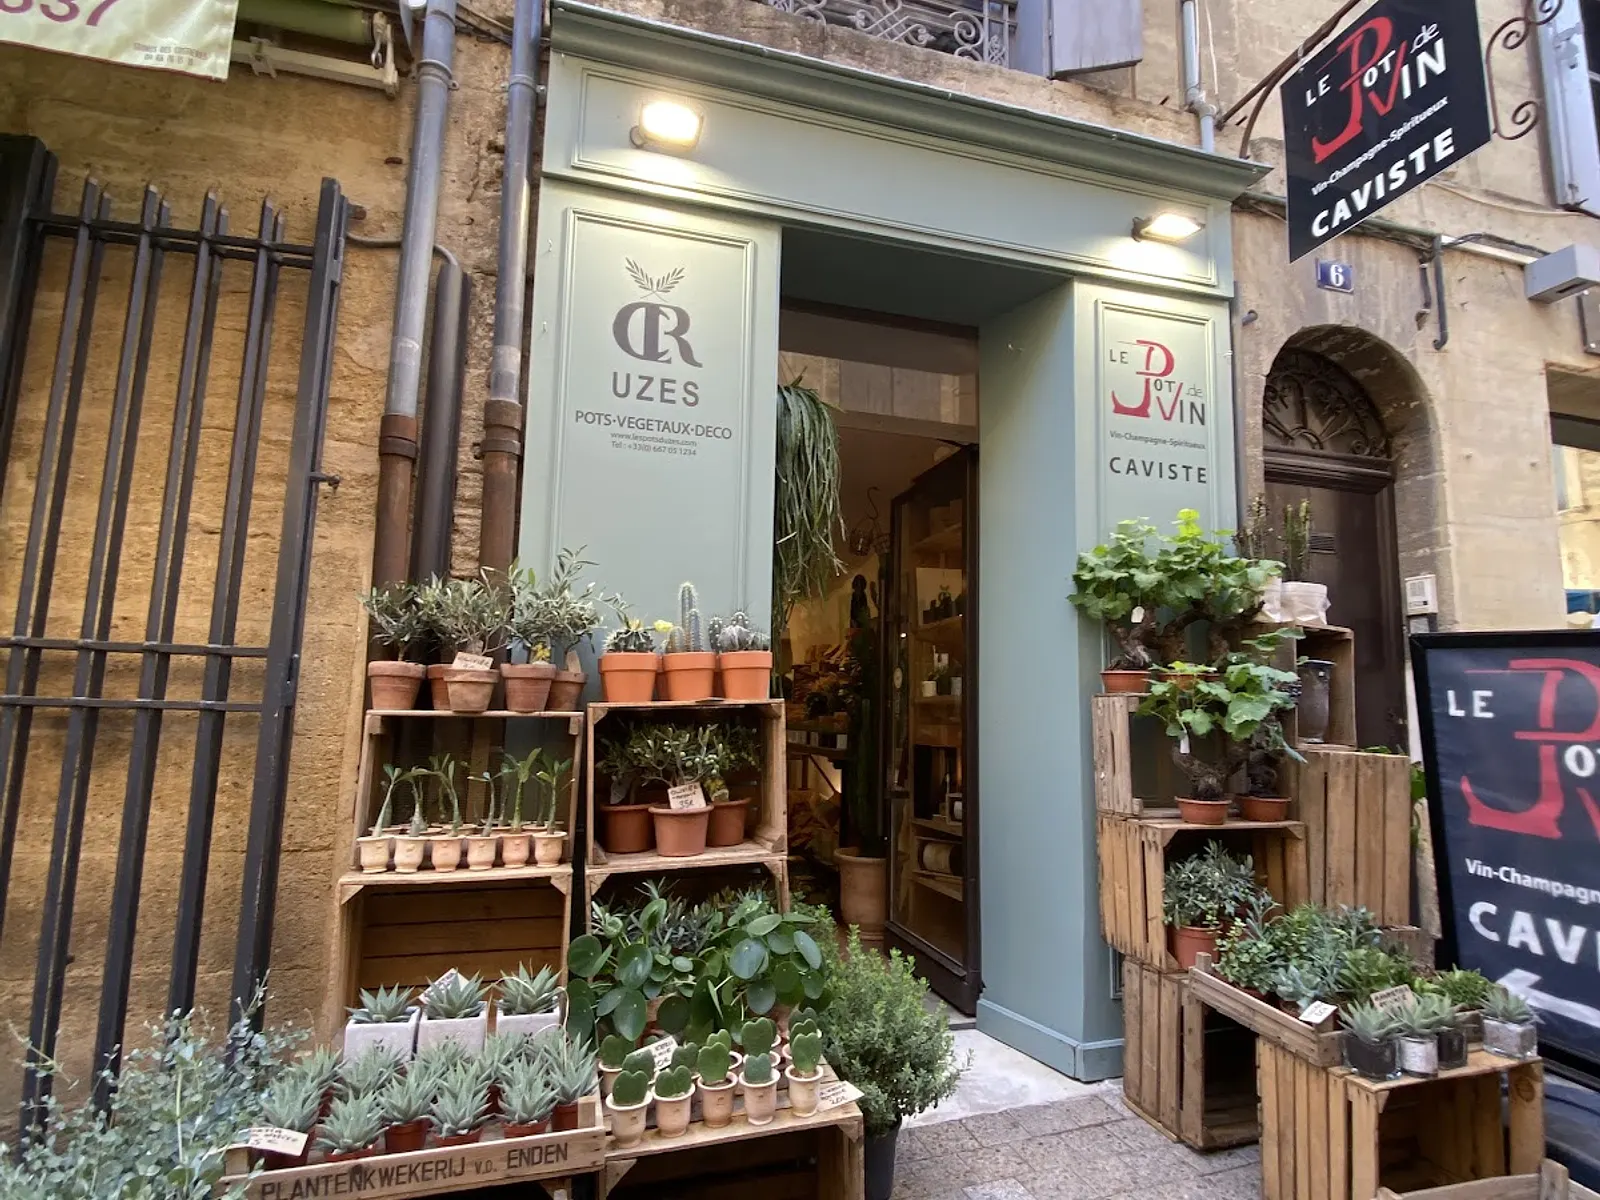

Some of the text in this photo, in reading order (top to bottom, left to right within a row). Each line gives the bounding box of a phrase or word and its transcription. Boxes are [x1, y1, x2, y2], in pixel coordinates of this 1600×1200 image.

[1305, 73, 1331, 107] LE
[1311, 96, 1449, 196] Vin-Champagne-Spiritueux
[1311, 127, 1455, 238] CAVISTE
[1330, 266, 1344, 286] 6
[1109, 349, 1129, 364] LE
[612, 371, 700, 408] UZES
[1109, 457, 1207, 484] CAVISTE
[1446, 690, 1495, 719] LE
[507, 1143, 568, 1170] ENDEN
